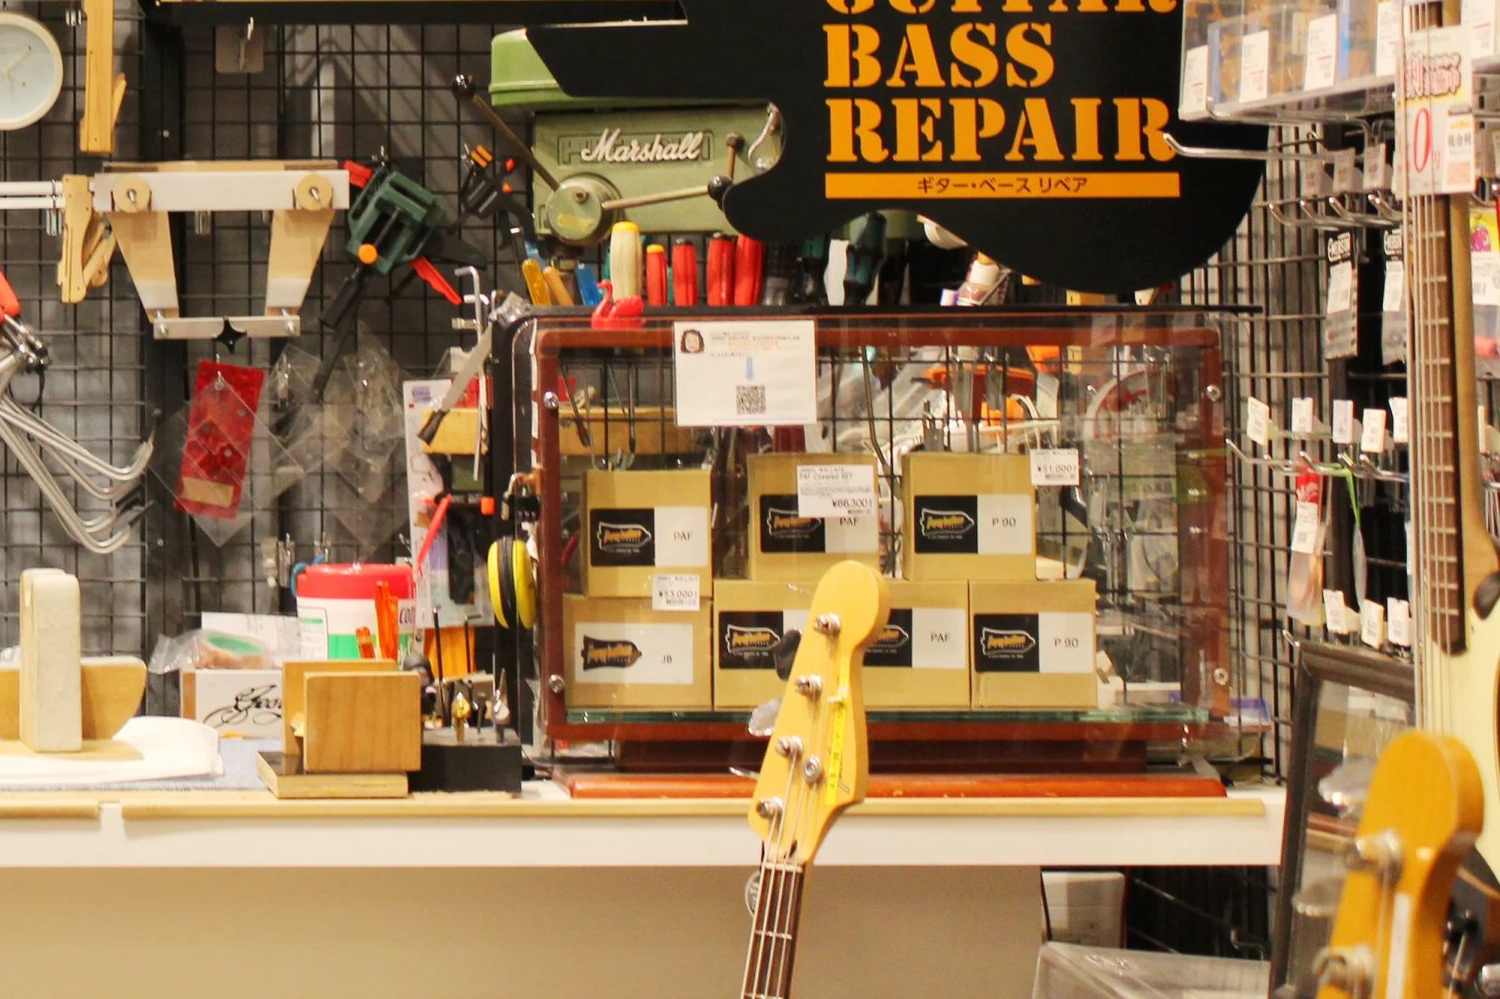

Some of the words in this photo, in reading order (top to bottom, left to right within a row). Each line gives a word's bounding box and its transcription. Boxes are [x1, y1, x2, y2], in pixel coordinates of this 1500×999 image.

[824, 22, 1055, 89] BASS
[580, 127, 704, 163] Marshall
[825, 97, 1177, 163] REPAIR
[917, 175, 1032, 196] ギター・ベース
[1039, 175, 1088, 196] リペア
